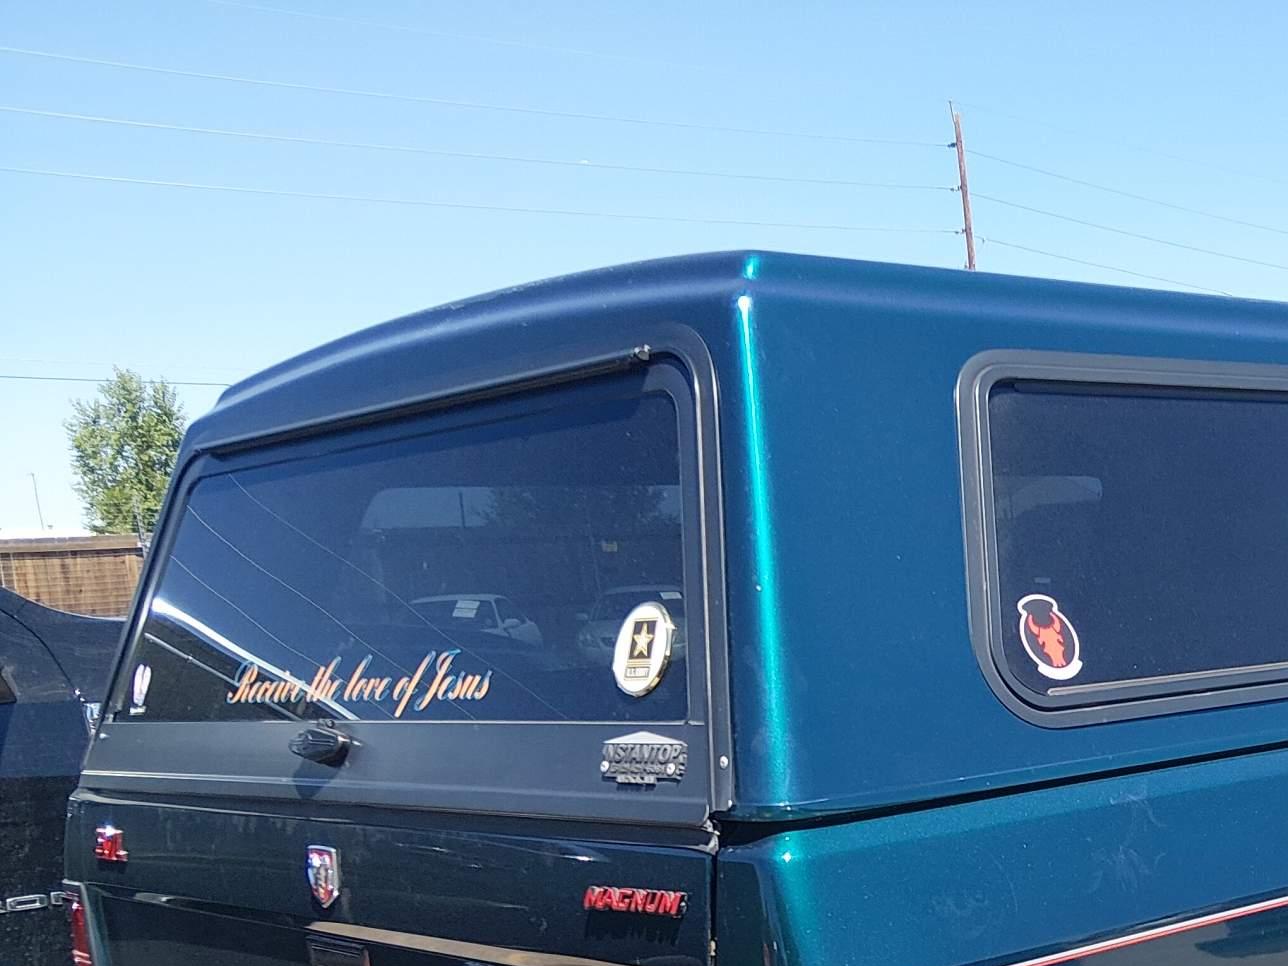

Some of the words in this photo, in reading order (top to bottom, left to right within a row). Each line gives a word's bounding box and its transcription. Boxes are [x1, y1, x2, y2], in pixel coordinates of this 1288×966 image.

[226, 660, 304, 704] Receive
[304, 655, 342, 702] the
[343, 654, 392, 702] love
[392, 651, 436, 718] of
[414, 650, 493, 711] Jesus
[584, 886, 687, 918] MAGNUM
